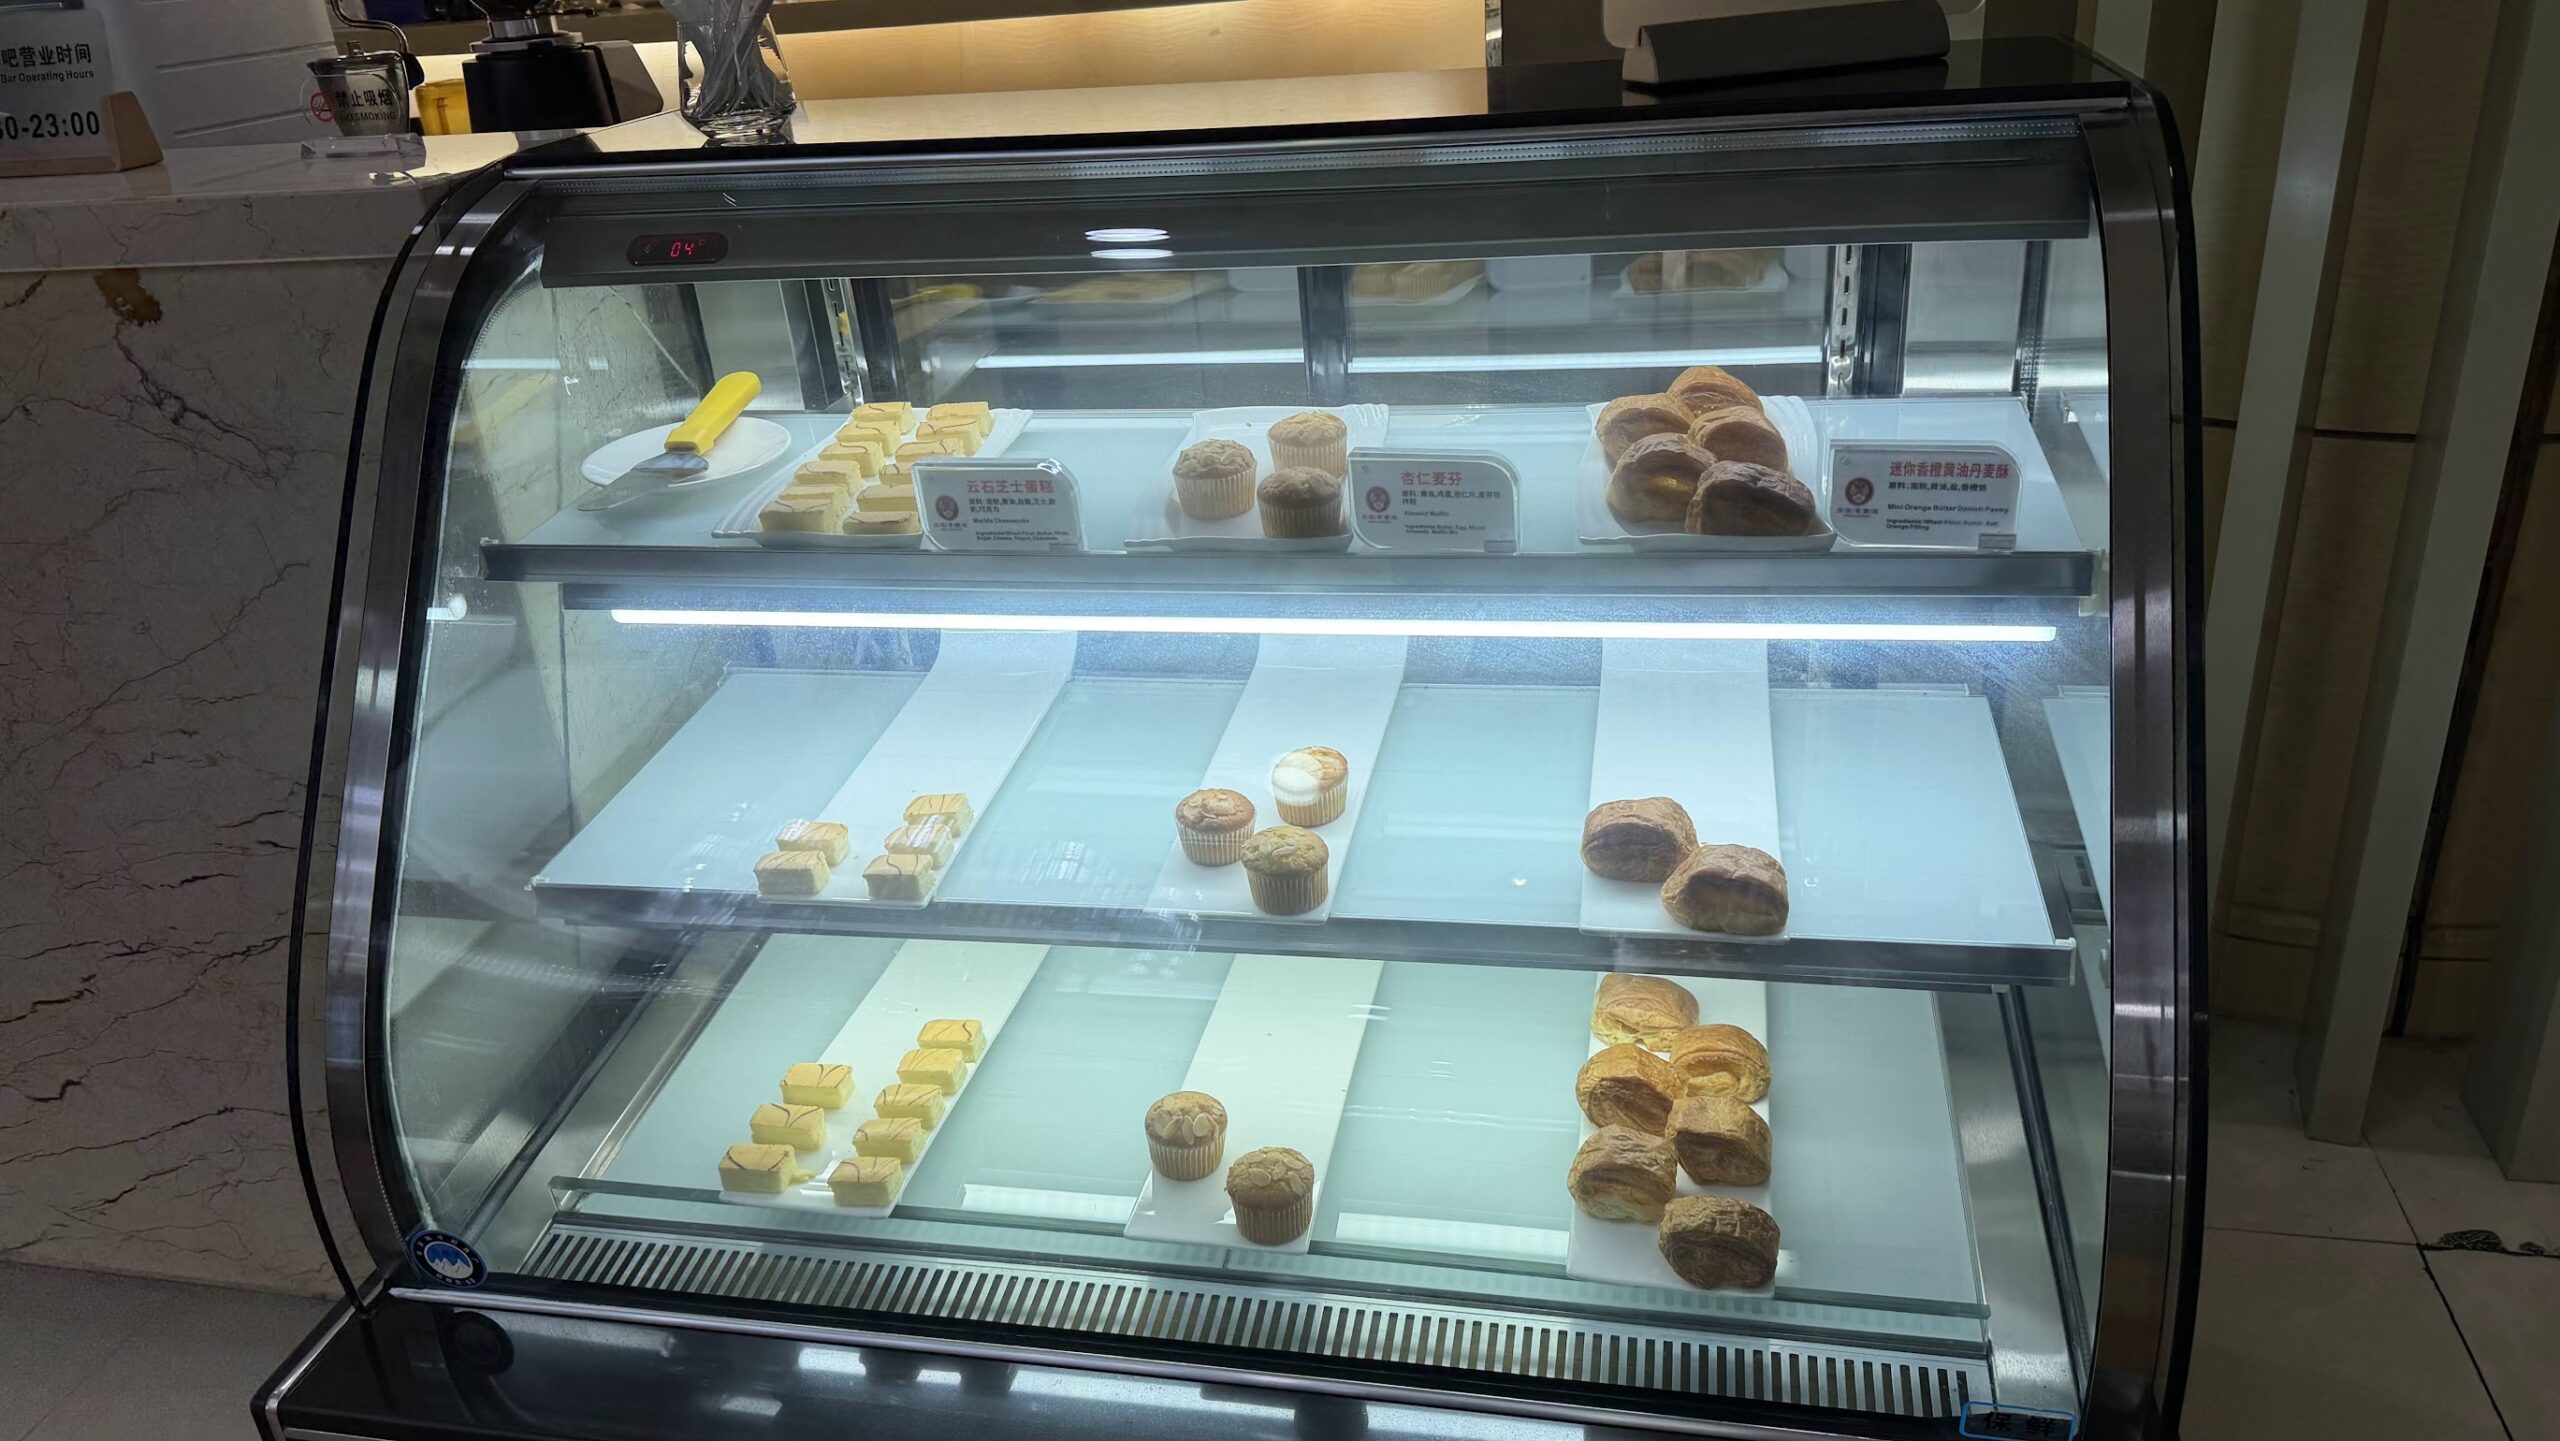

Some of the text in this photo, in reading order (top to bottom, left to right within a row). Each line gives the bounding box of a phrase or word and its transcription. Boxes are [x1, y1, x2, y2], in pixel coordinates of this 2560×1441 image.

[0, 43, 92, 68] 吧营业时间
[18, 70, 64, 84] Operating
[66, 70, 95, 80] Hours
[335, 88, 394, 109] 禁止吸烟
[356, 111, 397, 121] SMOKING
[669, 240, 695, 258] 04
[1889, 461, 2009, 479] 迷你香橙黄油丹麦酥
[966, 479, 1056, 494] 云石芝士蛋糕
[1401, 471, 1463, 486] 杏仁麦芬
[1887, 503, 1904, 511] Mini
[1904, 503, 1932, 512] Orange
[1983, 1411, 2057, 1438] 保鲜
